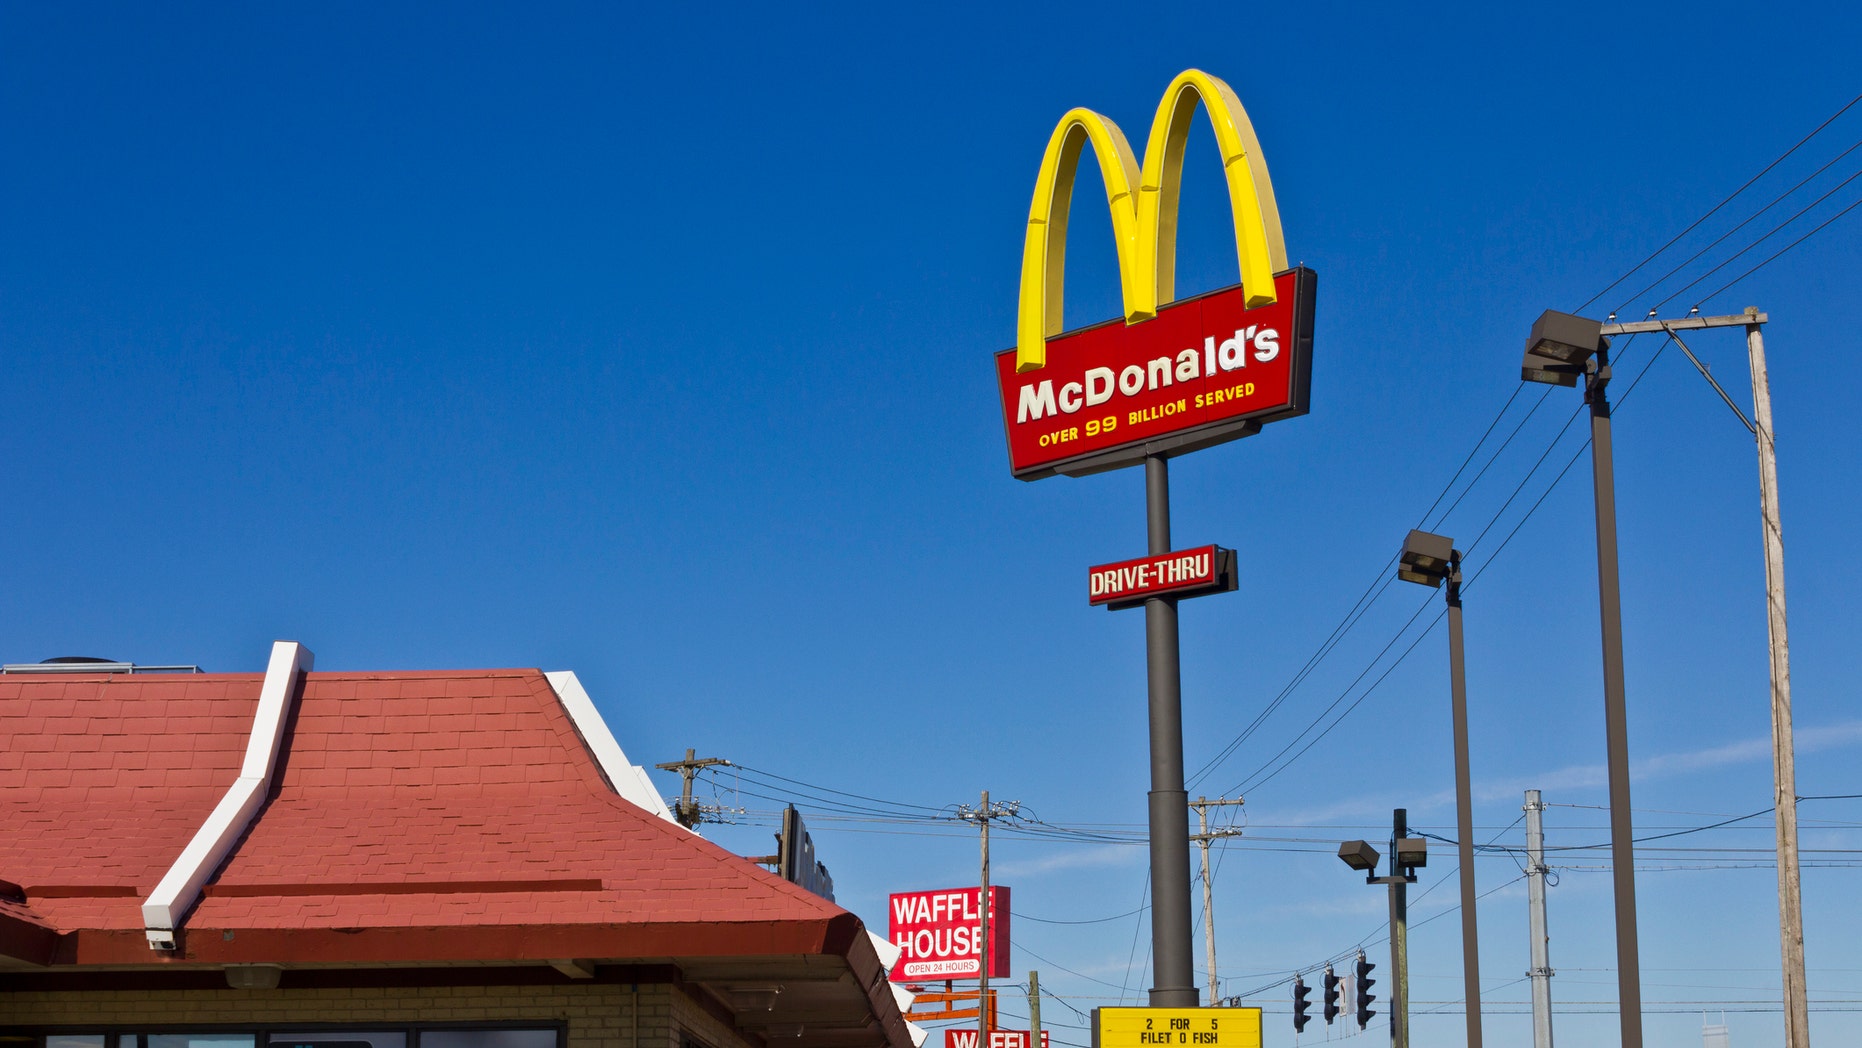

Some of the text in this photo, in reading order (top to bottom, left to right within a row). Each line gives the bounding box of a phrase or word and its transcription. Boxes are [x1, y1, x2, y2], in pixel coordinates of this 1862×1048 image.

[1017, 324, 1279, 424] McDonald's
[1039, 382, 1255, 447] OVER 99 BILLION SERVED
[1091, 553, 1209, 596] DRIVE-THRU
[909, 961, 975, 973] OPEN 24 HOURS
[1146, 1018, 1218, 1030] 2 FOR 5
[1141, 1032, 1171, 1044] FILET
[1193, 1032, 1218, 1044] FISH
